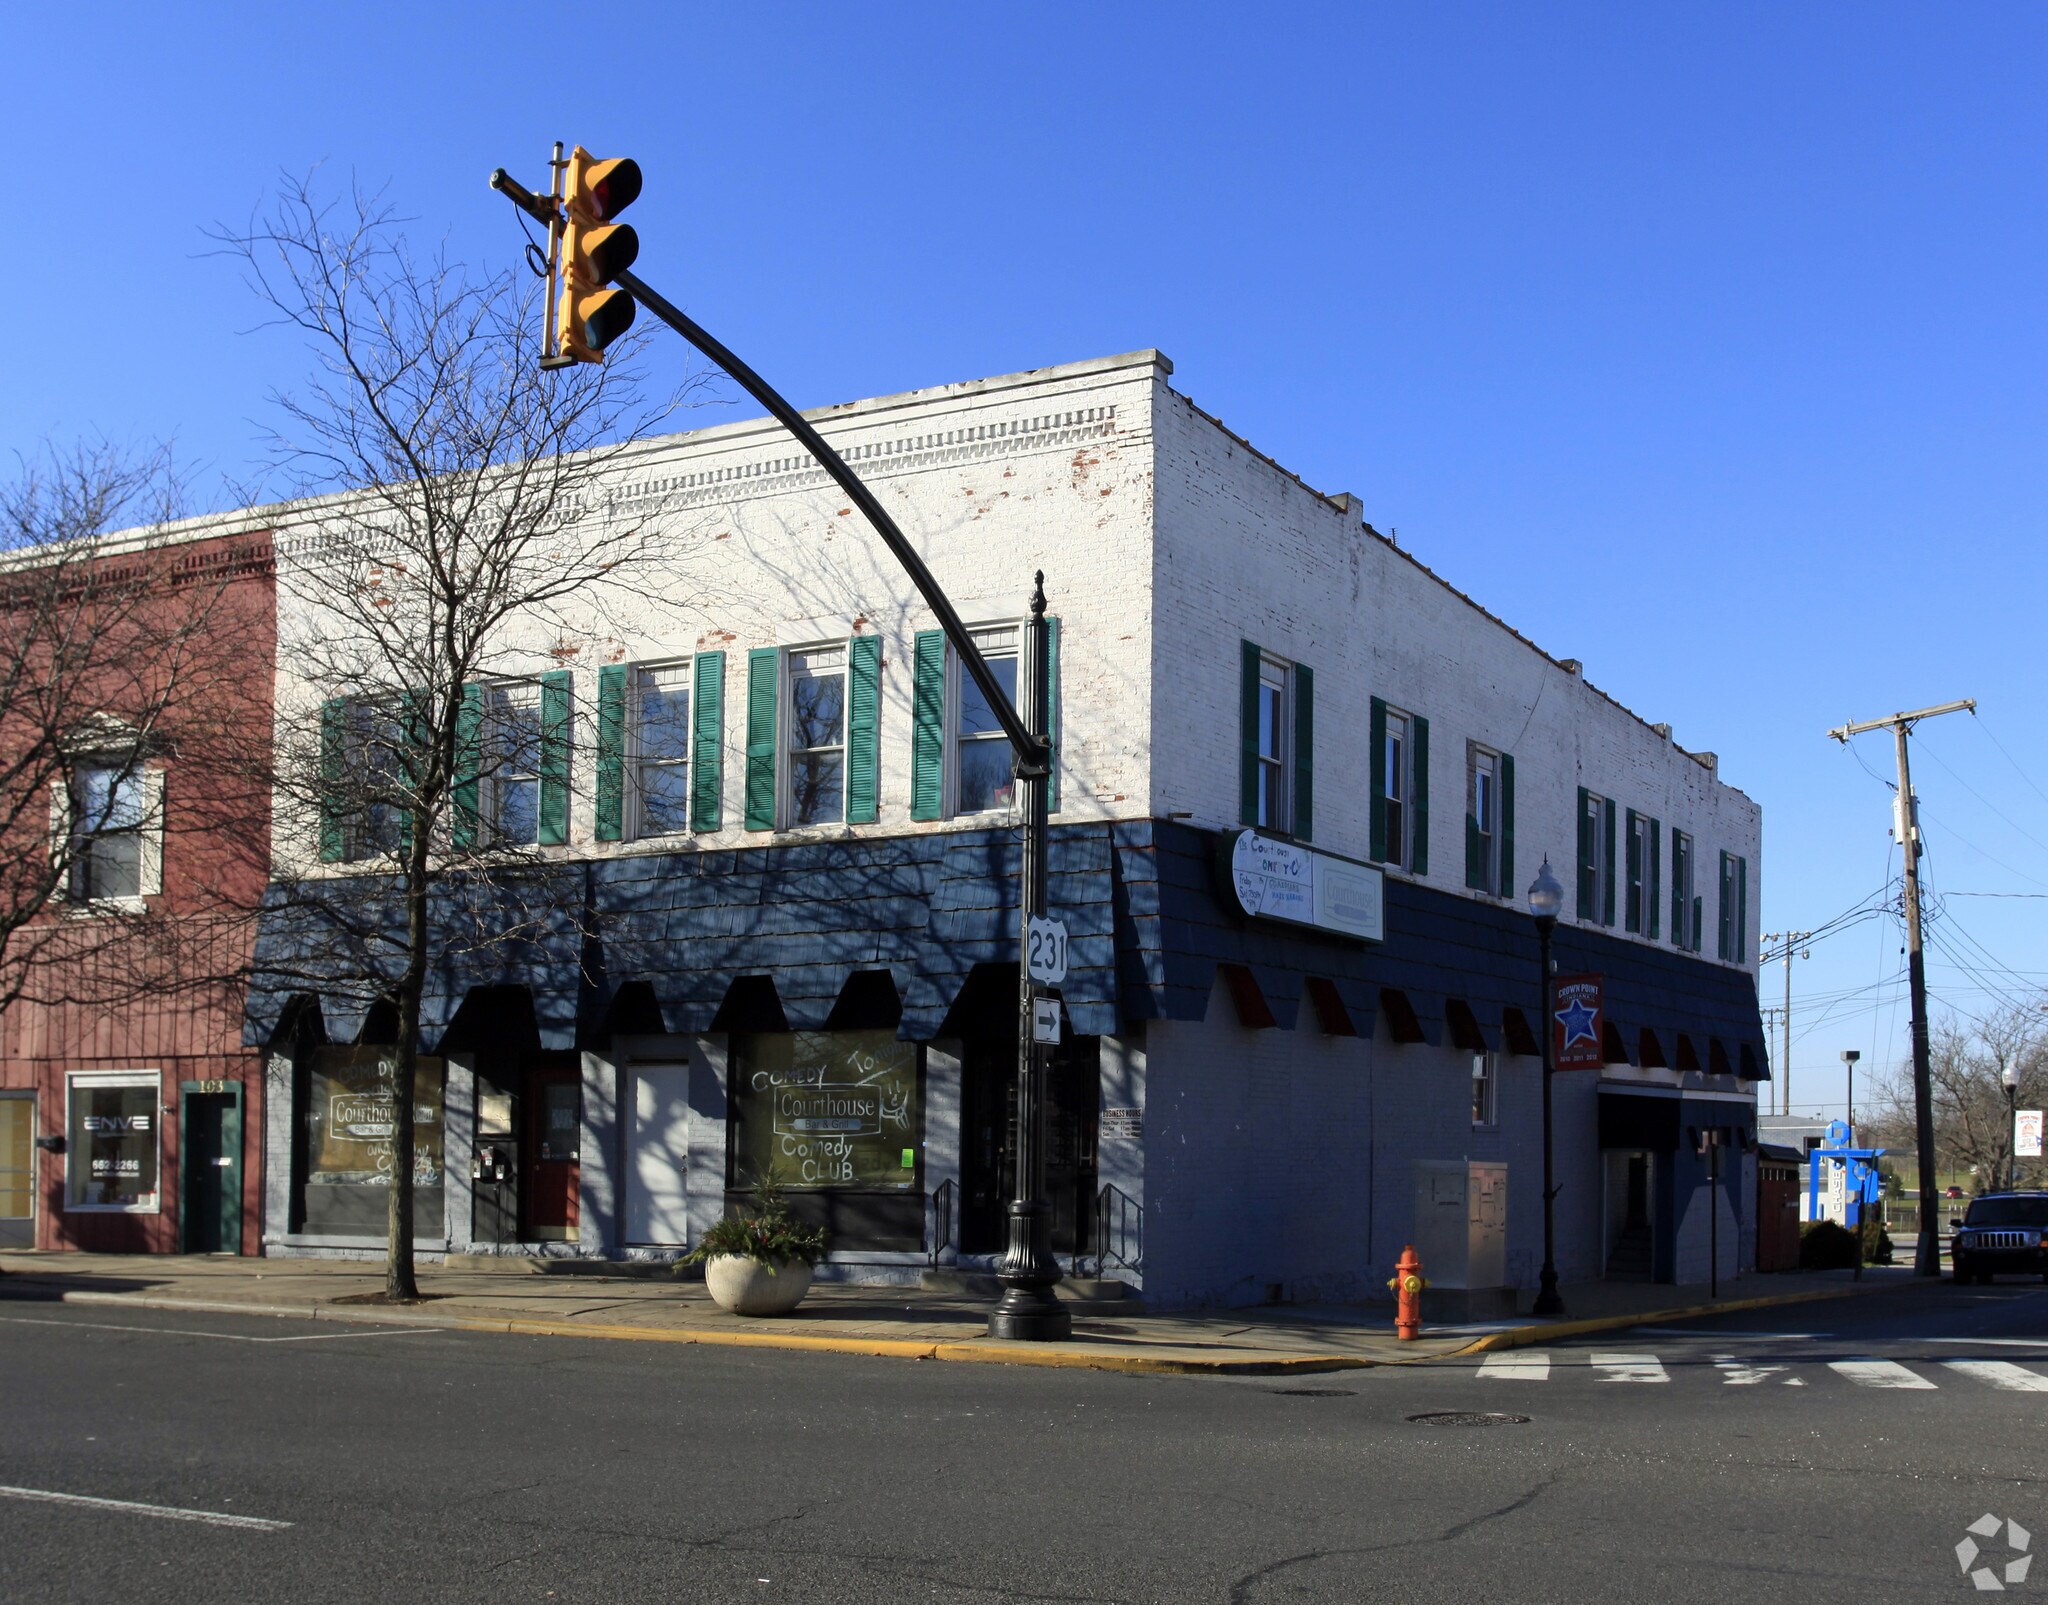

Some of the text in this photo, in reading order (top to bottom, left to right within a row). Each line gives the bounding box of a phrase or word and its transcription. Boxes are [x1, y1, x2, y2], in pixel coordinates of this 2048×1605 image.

[1030, 929, 1065, 972] 231
[1558, 983, 1599, 999] CROWN POINT
[198, 1080, 225, 1094] 103
[751, 1065, 827, 1093] COMEDY
[781, 1093, 875, 1117] Courthouse
[1103, 1109, 1142, 1118] BUSINESS HOURS
[84, 1115, 150, 1131] ENVE
[805, 1120, 849, 1129] Bar & Grill
[781, 1133, 854, 1162] Comedy
[801, 1159, 854, 1182] CLUB
[1832, 1171, 1843, 1213] CHASE
